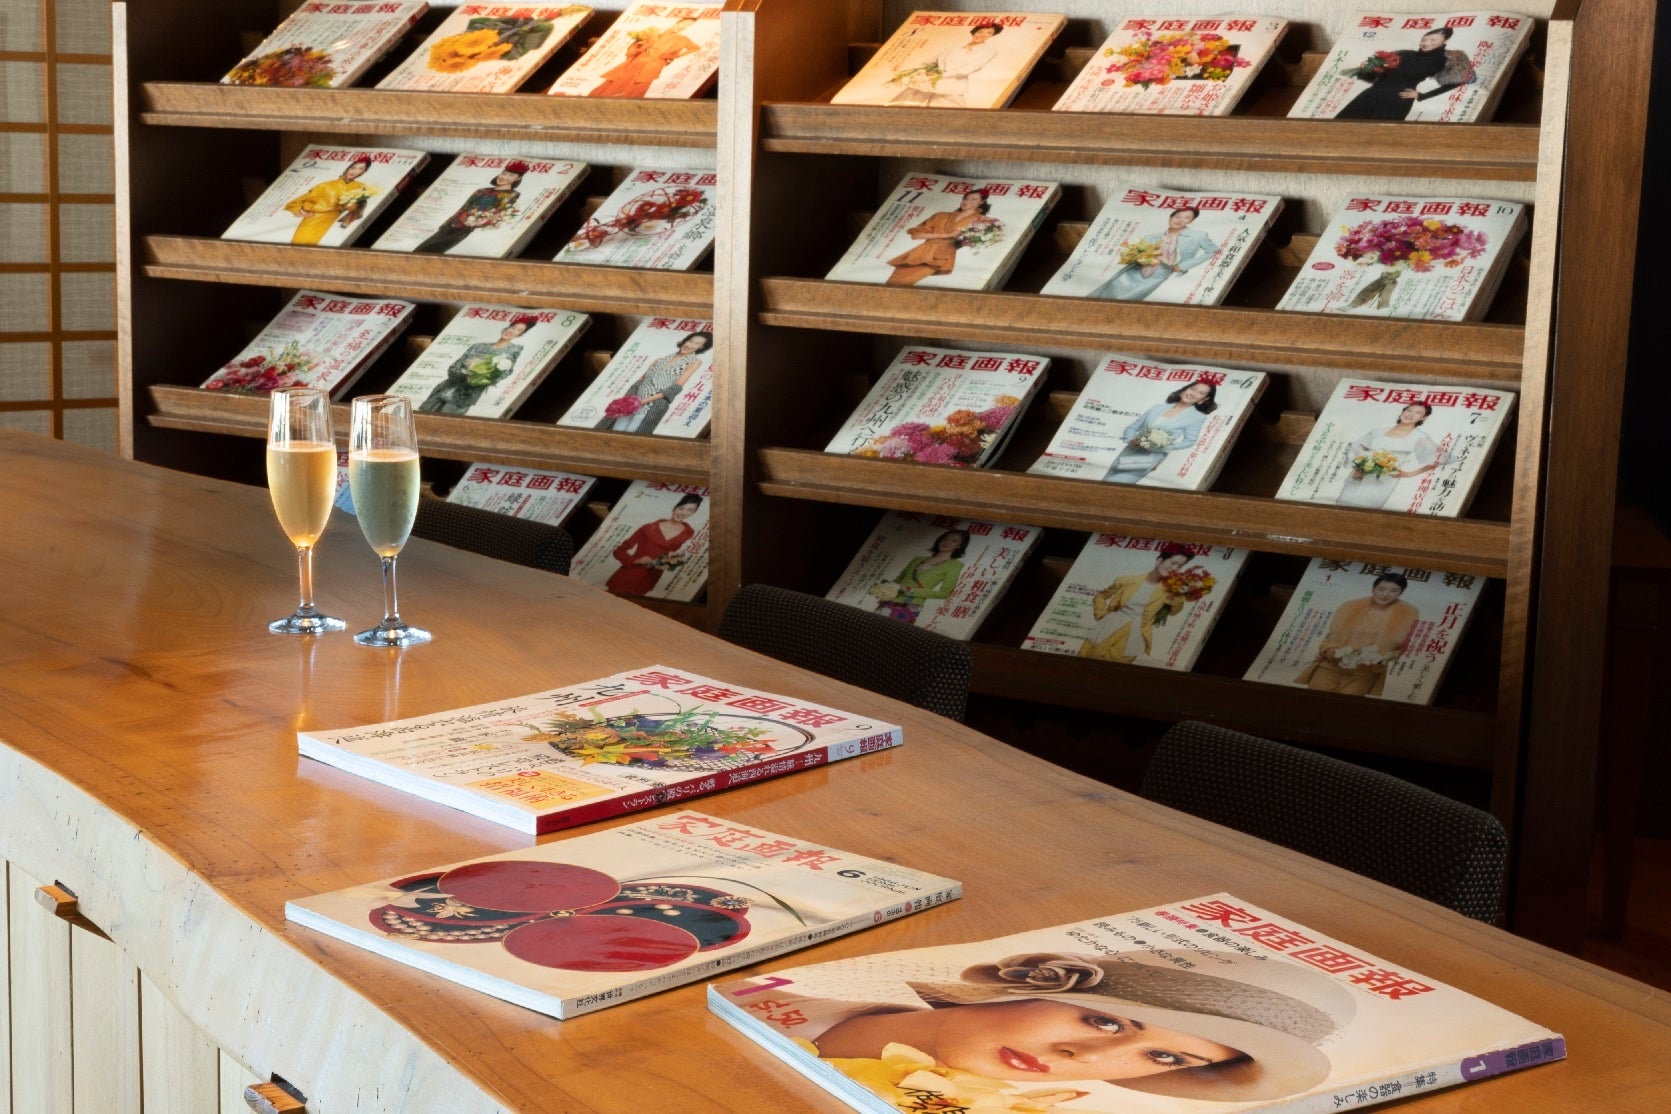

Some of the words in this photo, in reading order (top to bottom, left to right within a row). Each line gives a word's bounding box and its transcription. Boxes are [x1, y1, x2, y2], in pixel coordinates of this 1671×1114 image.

[910, 15, 1027, 27] 家庭画報
[1122, 19, 1257, 32] 家庭画報
[1358, 15, 1522, 30] 家庭画報
[558, 164, 573, 174] 2
[903, 177, 1050, 199] 家庭画報
[1121, 189, 1268, 214] 家庭画報
[1344, 197, 1492, 217] 家庭画報
[1496, 205, 1514, 216] 10
[293, 295, 405, 318] 家庭画報
[561, 314, 576, 328] 8
[900, 351, 1041, 376] 家庭画報
[1104, 359, 1227, 386] 家庭画報
[1343, 385, 1502, 411] 家庭画報
[1470, 412, 1481, 424] 7
[466, 467, 588, 495] 家庭画報
[1317, 558, 1476, 590] 家庭画報
[625, 671, 849, 729] 家庭画報
[658, 815, 843, 871] 家庭画報
[837, 869, 866, 878] 6
[1180, 899, 1436, 1000] 家庭画報
[731, 976, 795, 997] 1
[1469, 1059, 1488, 1074] 1
